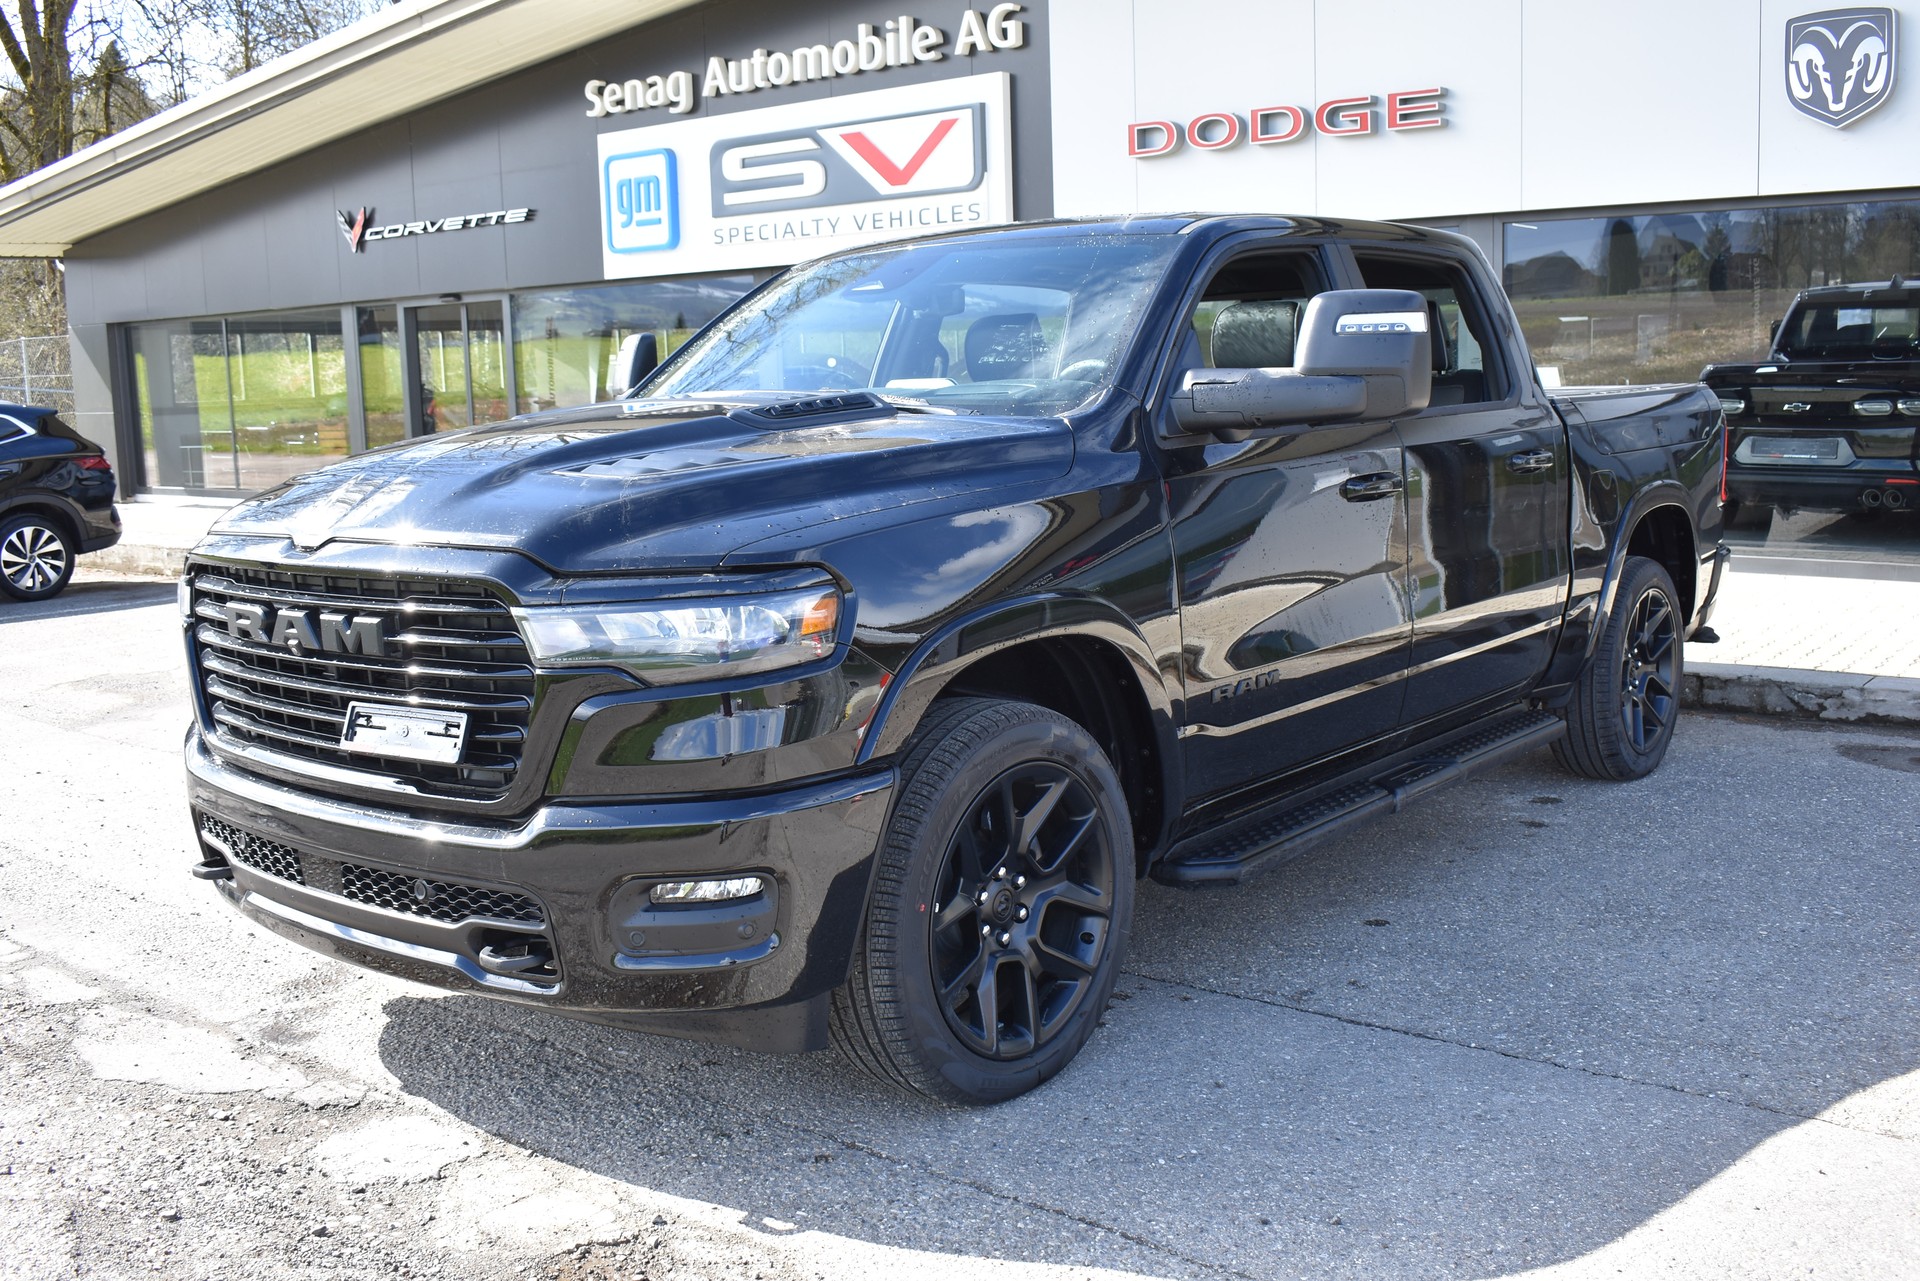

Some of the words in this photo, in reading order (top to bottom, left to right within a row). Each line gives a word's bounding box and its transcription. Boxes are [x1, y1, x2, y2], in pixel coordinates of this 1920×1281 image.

[584, 71, 694, 117] Senag
[702, 16, 945, 97] Automobile
[954, 3, 1024, 56] AG
[1128, 87, 1446, 158] DODGE
[364, 207, 529, 241] CORVETTE
[616, 174, 662, 228] gm
[713, 217, 841, 246] SPECIALTY
[853, 203, 981, 231] VEHICLES
[225, 601, 386, 657] RAM
[1211, 668, 1281, 704] RAM
